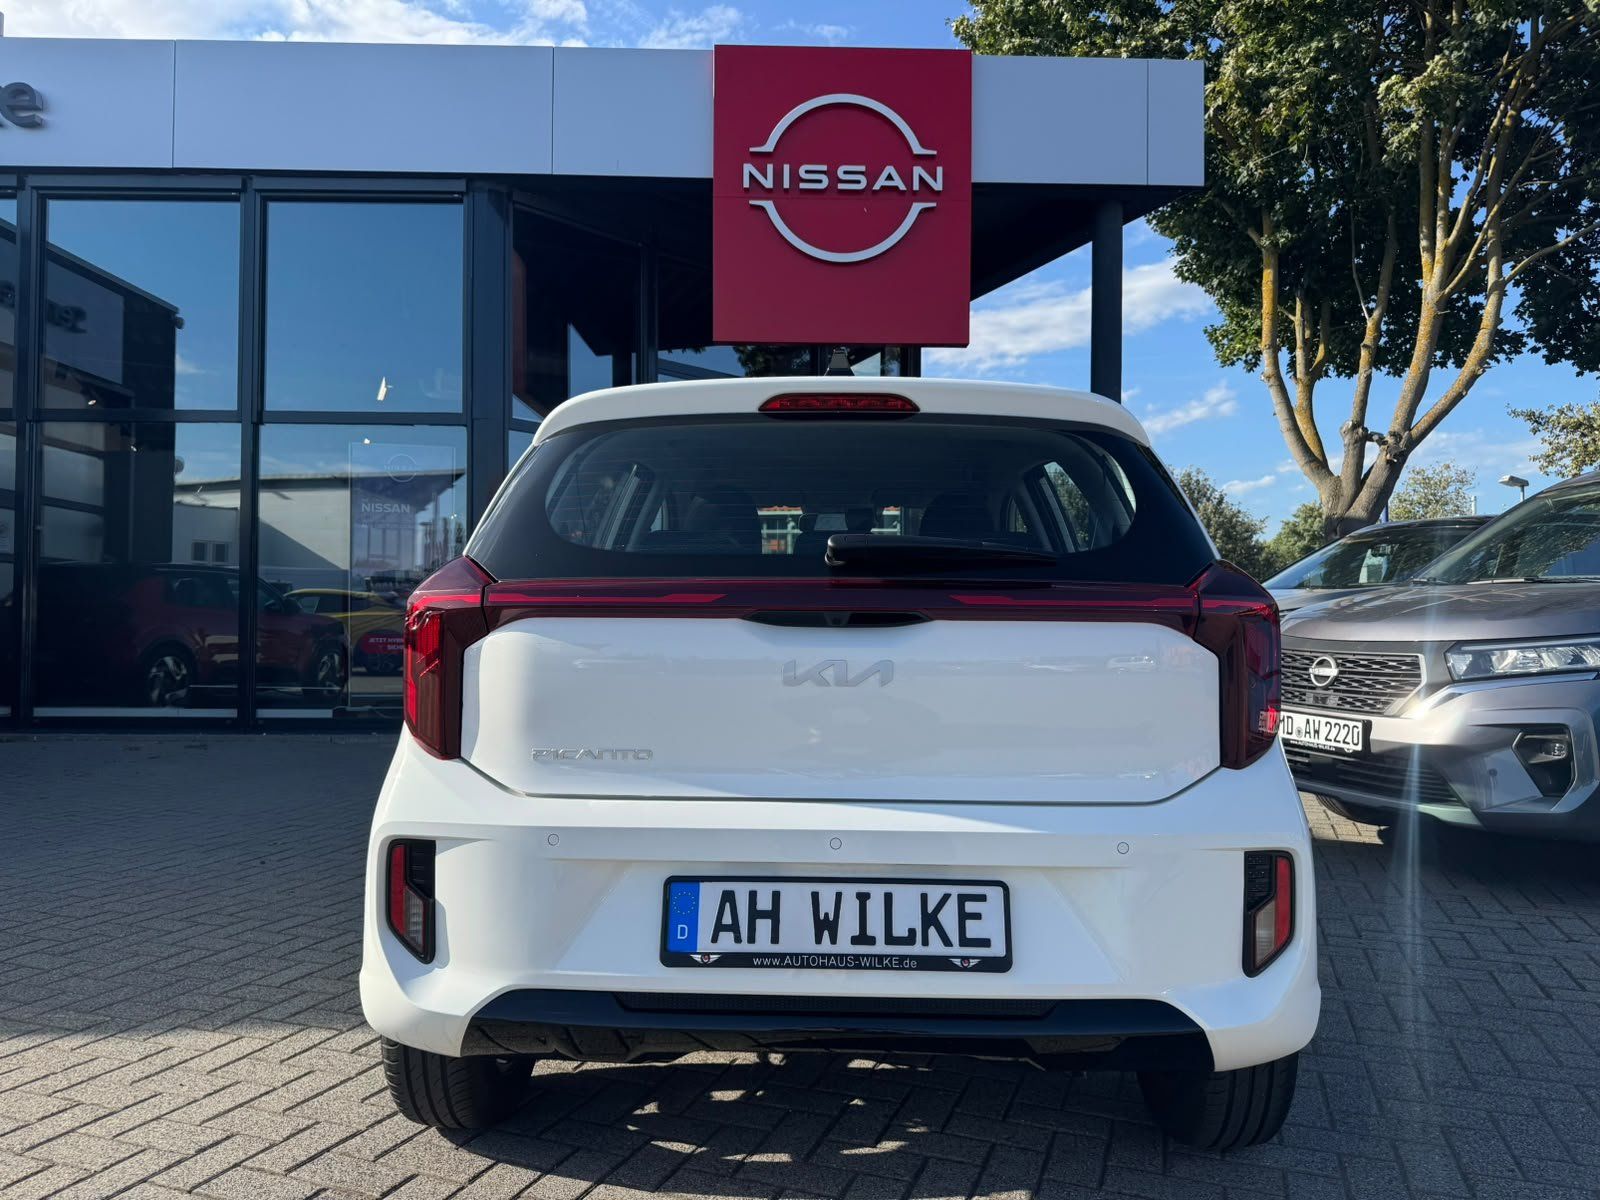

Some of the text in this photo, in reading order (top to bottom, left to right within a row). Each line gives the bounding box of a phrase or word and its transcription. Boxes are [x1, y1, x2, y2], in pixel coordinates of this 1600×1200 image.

[743, 163, 943, 191] NISSAN
[361, 503, 411, 513] NISSAN
[781, 659, 894, 687] KIA
[1304, 718, 1321, 740] AW
[1324, 721, 1360, 746] 2220
[532, 748, 653, 761] PICANTO
[677, 889, 992, 948] D AH WILKE
[752, 955, 918, 968] www.AUTOHAUS-WILKE.de
